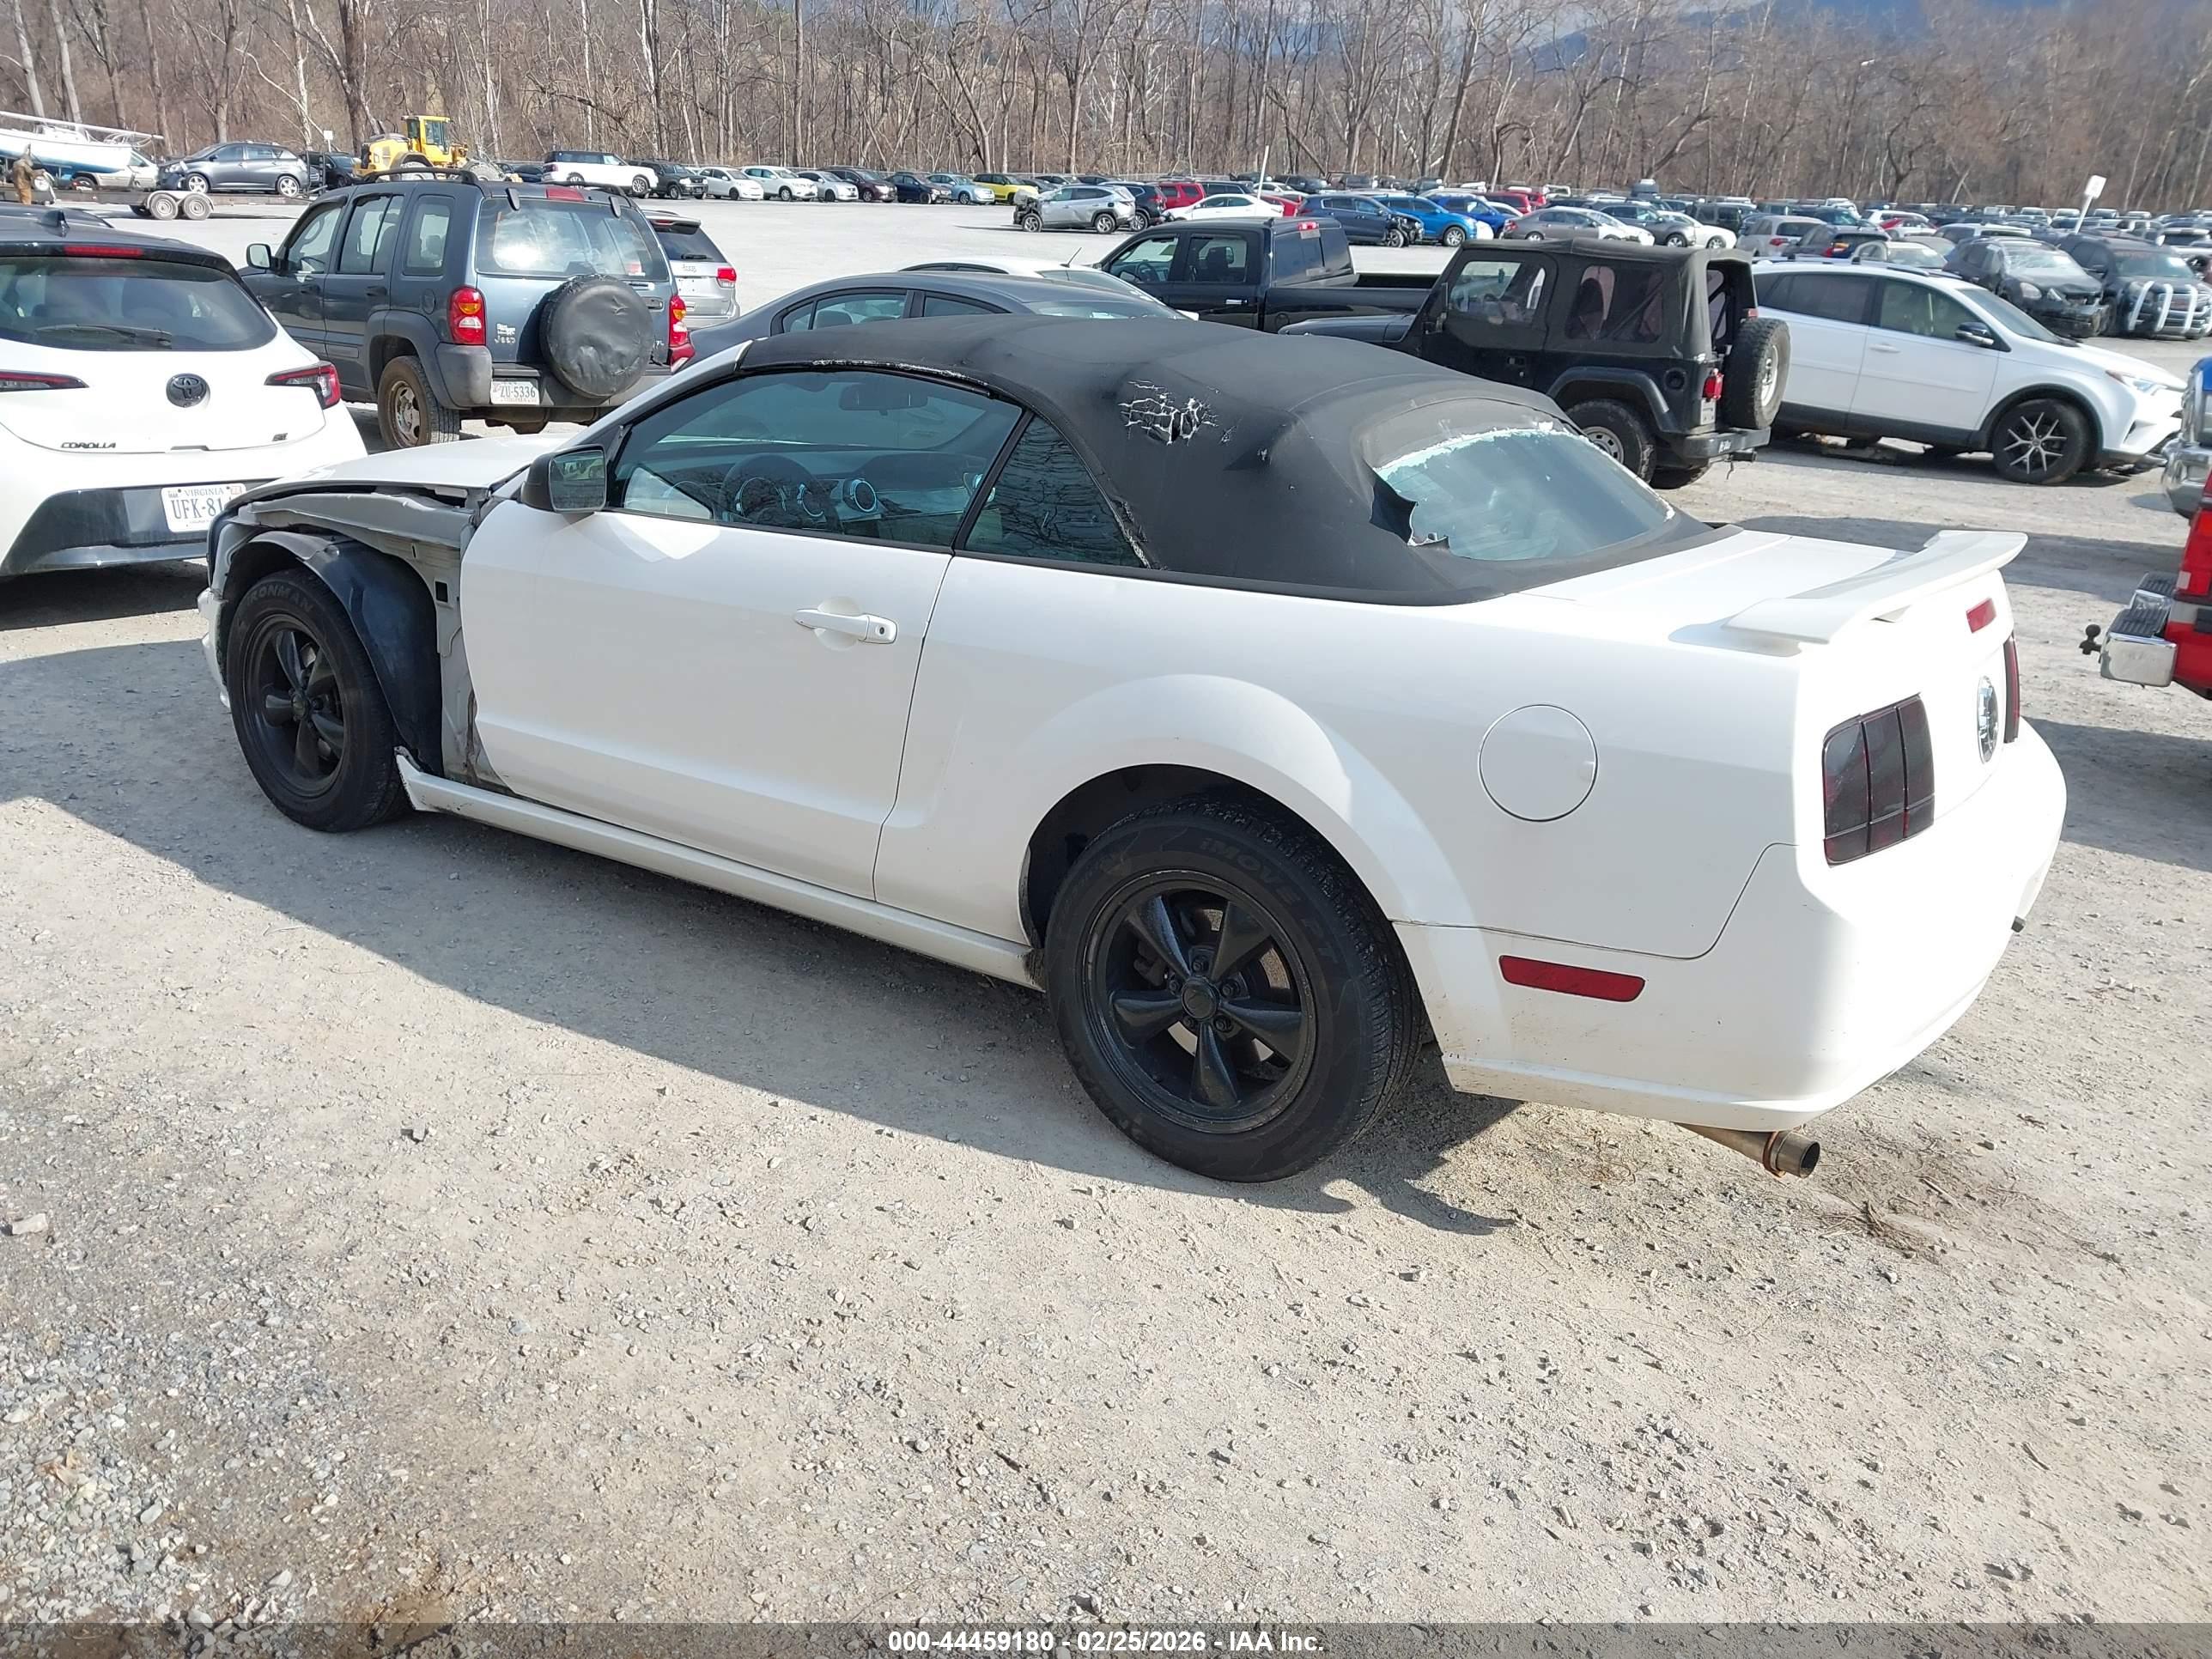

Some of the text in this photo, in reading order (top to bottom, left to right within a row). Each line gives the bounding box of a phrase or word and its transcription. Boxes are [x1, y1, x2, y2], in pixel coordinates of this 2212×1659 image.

[500, 385, 536, 398] ZU-5336
[185, 488, 224, 497] VIRGINIA
[246, 583, 314, 612] IRONMAN
